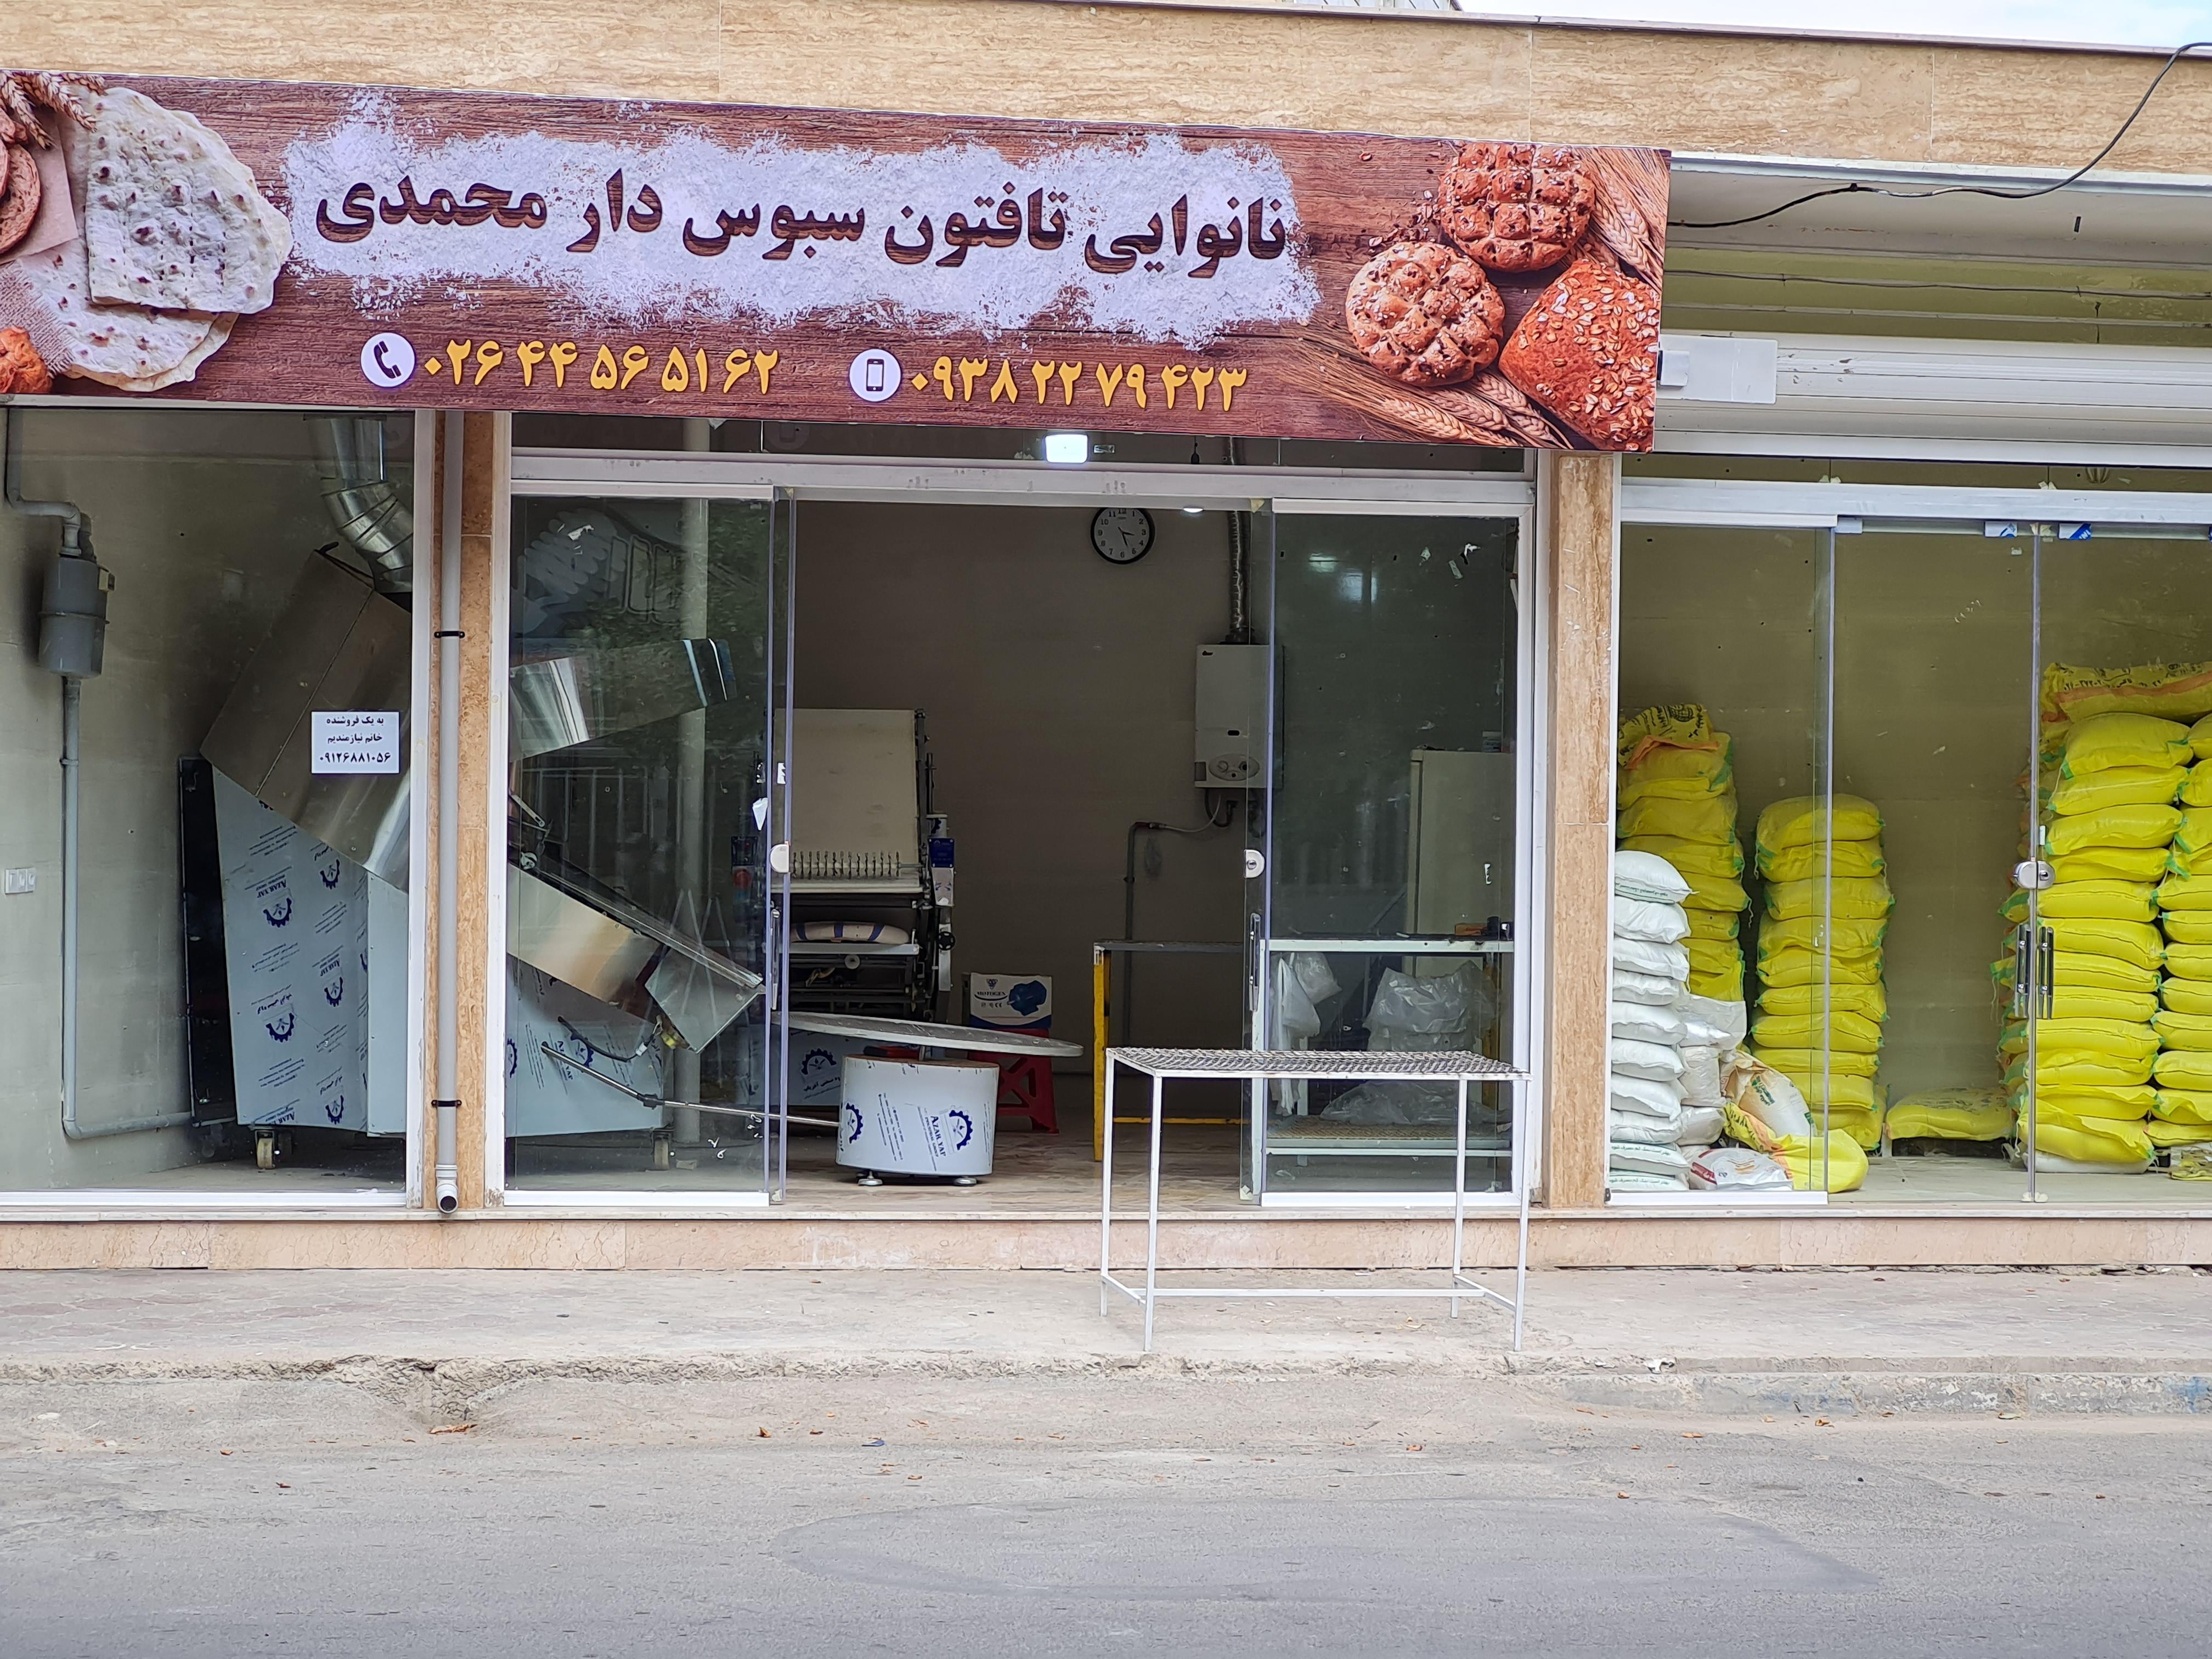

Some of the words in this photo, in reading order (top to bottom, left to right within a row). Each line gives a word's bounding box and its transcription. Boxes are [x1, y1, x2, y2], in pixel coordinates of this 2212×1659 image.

[315, 175, 548, 243] محمدی
[566, 167, 663, 253] دار
[682, 203, 865, 261] سبوس
[884, 181, 1069, 268] تافتون
[1084, 194, 1286, 279] نانوایی
[426, 341, 503, 385] ۰۲۶
[517, 341, 577, 387] ۴۴
[591, 345, 649, 390] ۵۶
[662, 348, 708, 392] ۵۱
[724, 350, 778, 393] ۶۲
[911, 357, 1018, 402] ۰۹۳۸
[1032, 362, 1082, 404] ۲۲
[1096, 364, 1147, 408] ۷۹
[1161, 365, 1247, 411] ۴۲۳
[326, 715, 359, 726] فروشنده
[328, 733, 363, 744] نیازمندیم
[362, 715, 374, 726] یک
[365, 733, 382, 744] خانم
[377, 718, 384, 726] به
[320, 752, 391, 763] ۰۹۱۲۶۸۸۱۰۵۶
[930, 1115, 941, 1140] AZAR
[938, 1141, 946, 1156] YAP
